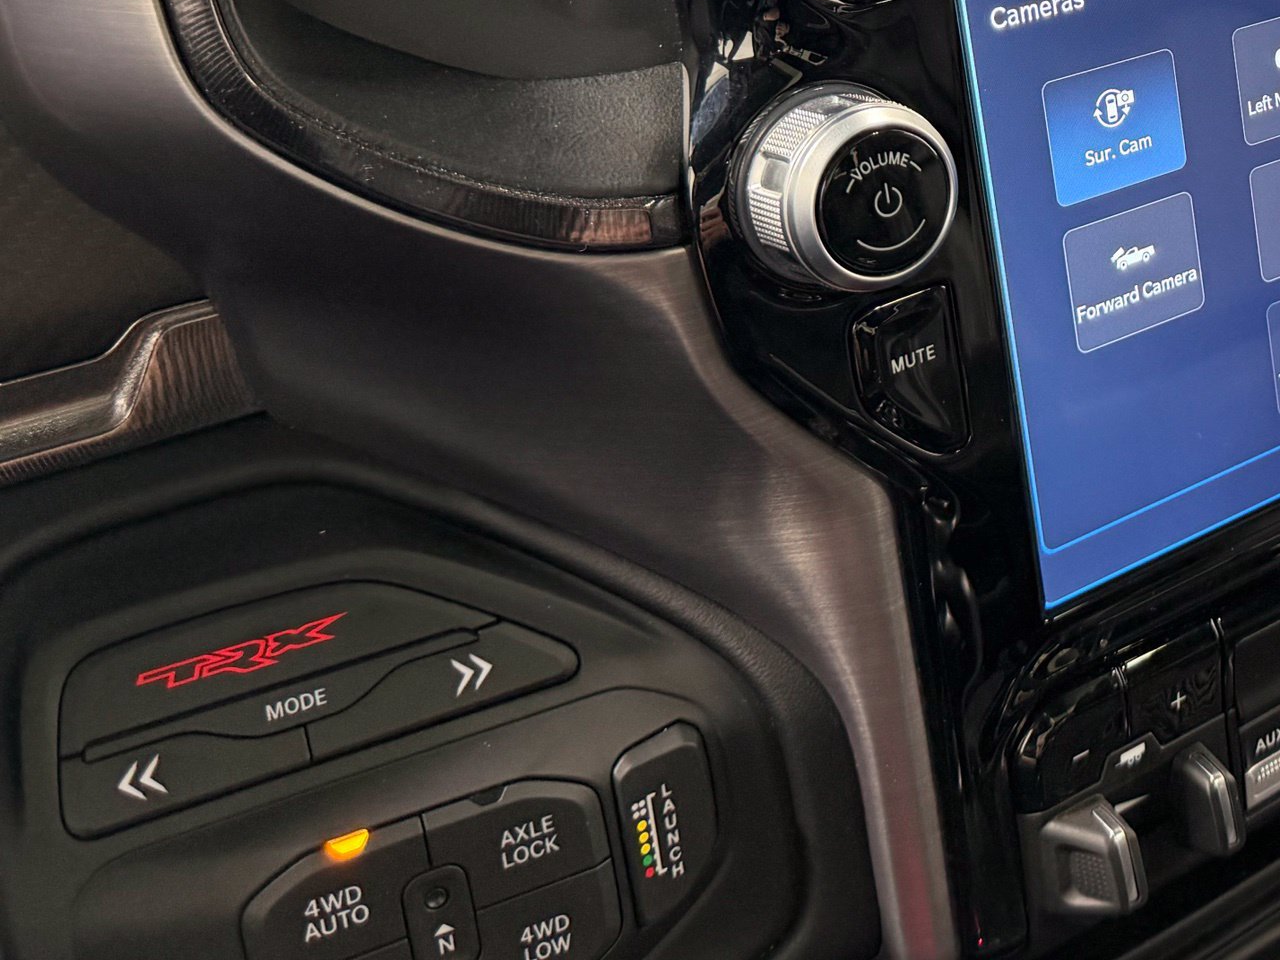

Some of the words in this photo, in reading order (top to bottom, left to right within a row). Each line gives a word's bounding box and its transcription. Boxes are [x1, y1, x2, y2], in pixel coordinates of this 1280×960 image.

[1247, 93, 1275, 117] Left
[851, 151, 911, 183] VOLUME
[1084, 142, 1116, 167] Sur.
[1119, 133, 1153, 157] Cam
[1076, 285, 1141, 325] Forward
[1142, 266, 1198, 298] Camera
[890, 343, 937, 375] MUTE
[136, 612, 348, 688] TRX
[264, 687, 328, 722] MODE
[500, 814, 556, 850] AXLE
[661, 783, 685, 879] LAUNCH
[501, 834, 560, 870] LOCK
[304, 885, 363, 918] 4WD
[305, 904, 370, 943] AUTO
[520, 913, 572, 944] 4WD
[438, 932, 456, 955] N
[523, 933, 572, 960] LOW
